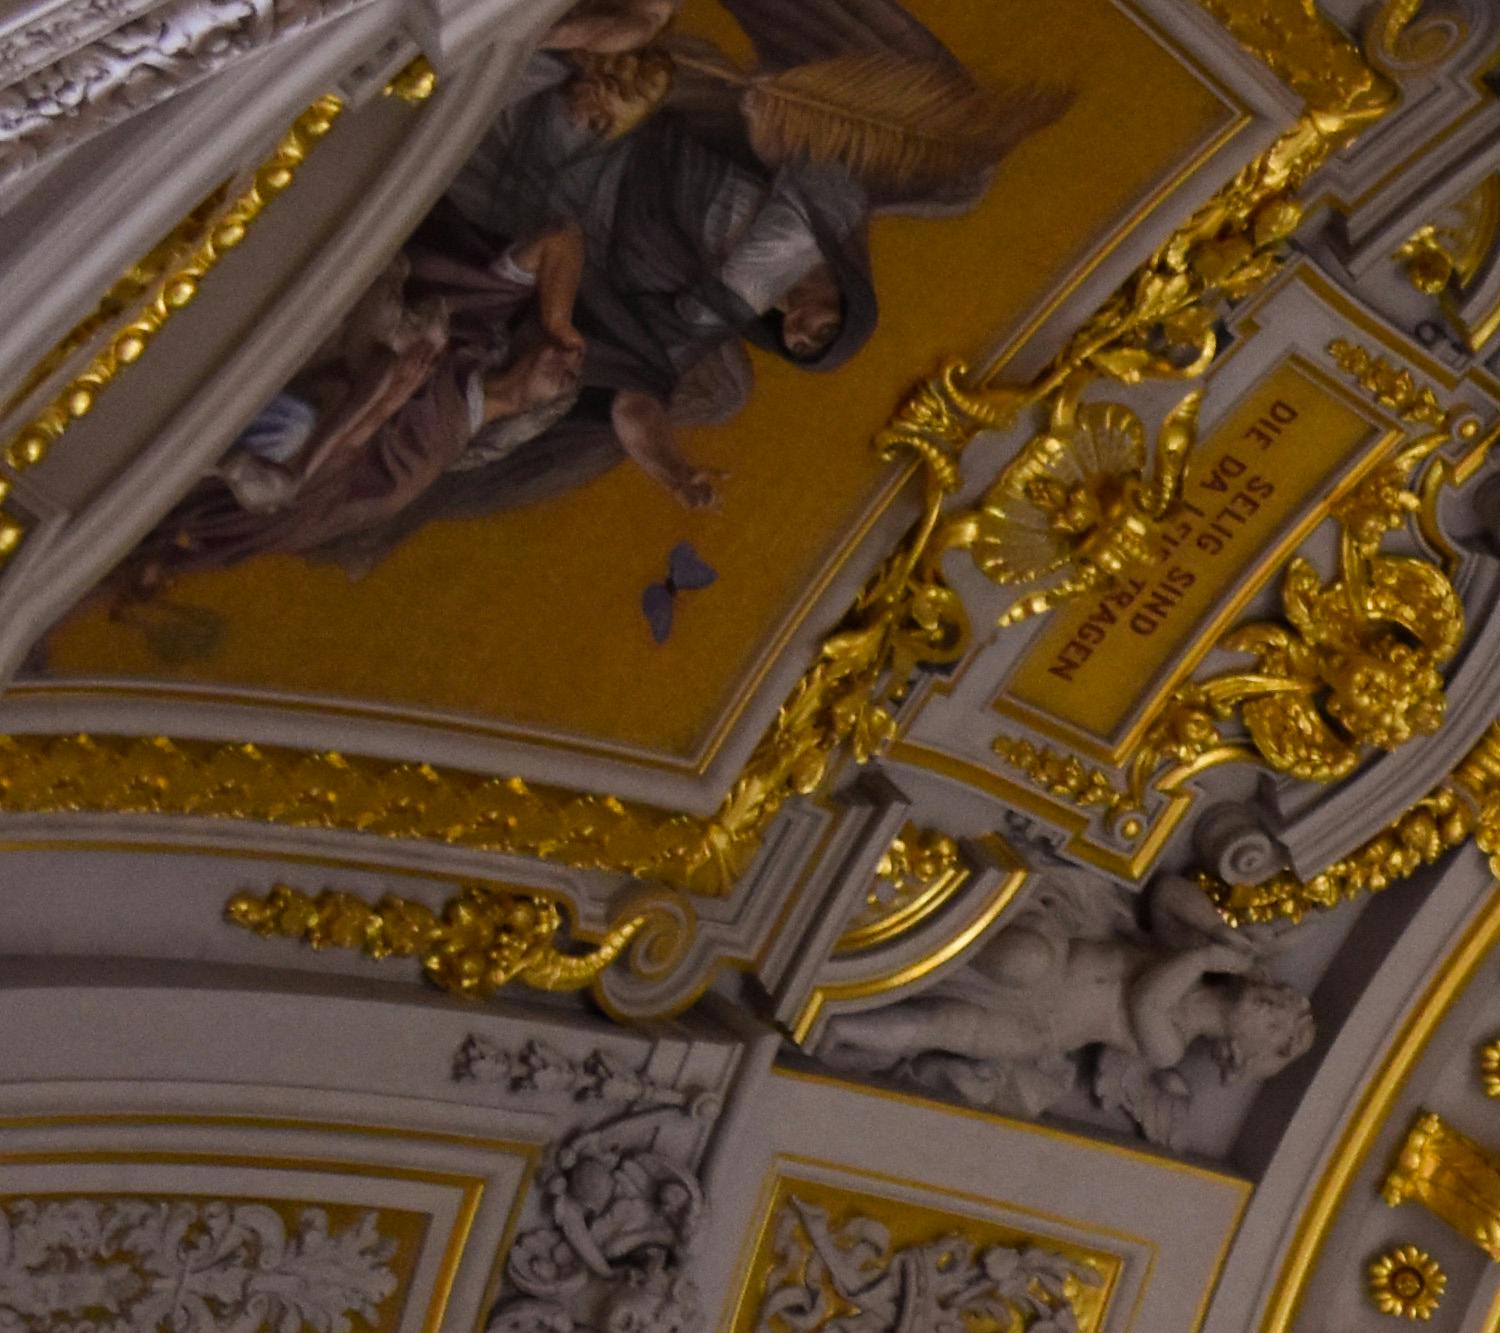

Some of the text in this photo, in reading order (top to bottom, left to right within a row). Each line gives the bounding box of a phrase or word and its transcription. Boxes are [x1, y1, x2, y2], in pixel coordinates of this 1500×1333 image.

[1242, 400, 1299, 450] DIE
[1200, 455, 1247, 494] DA
[1130, 476, 1275, 636] SELIG SIND
